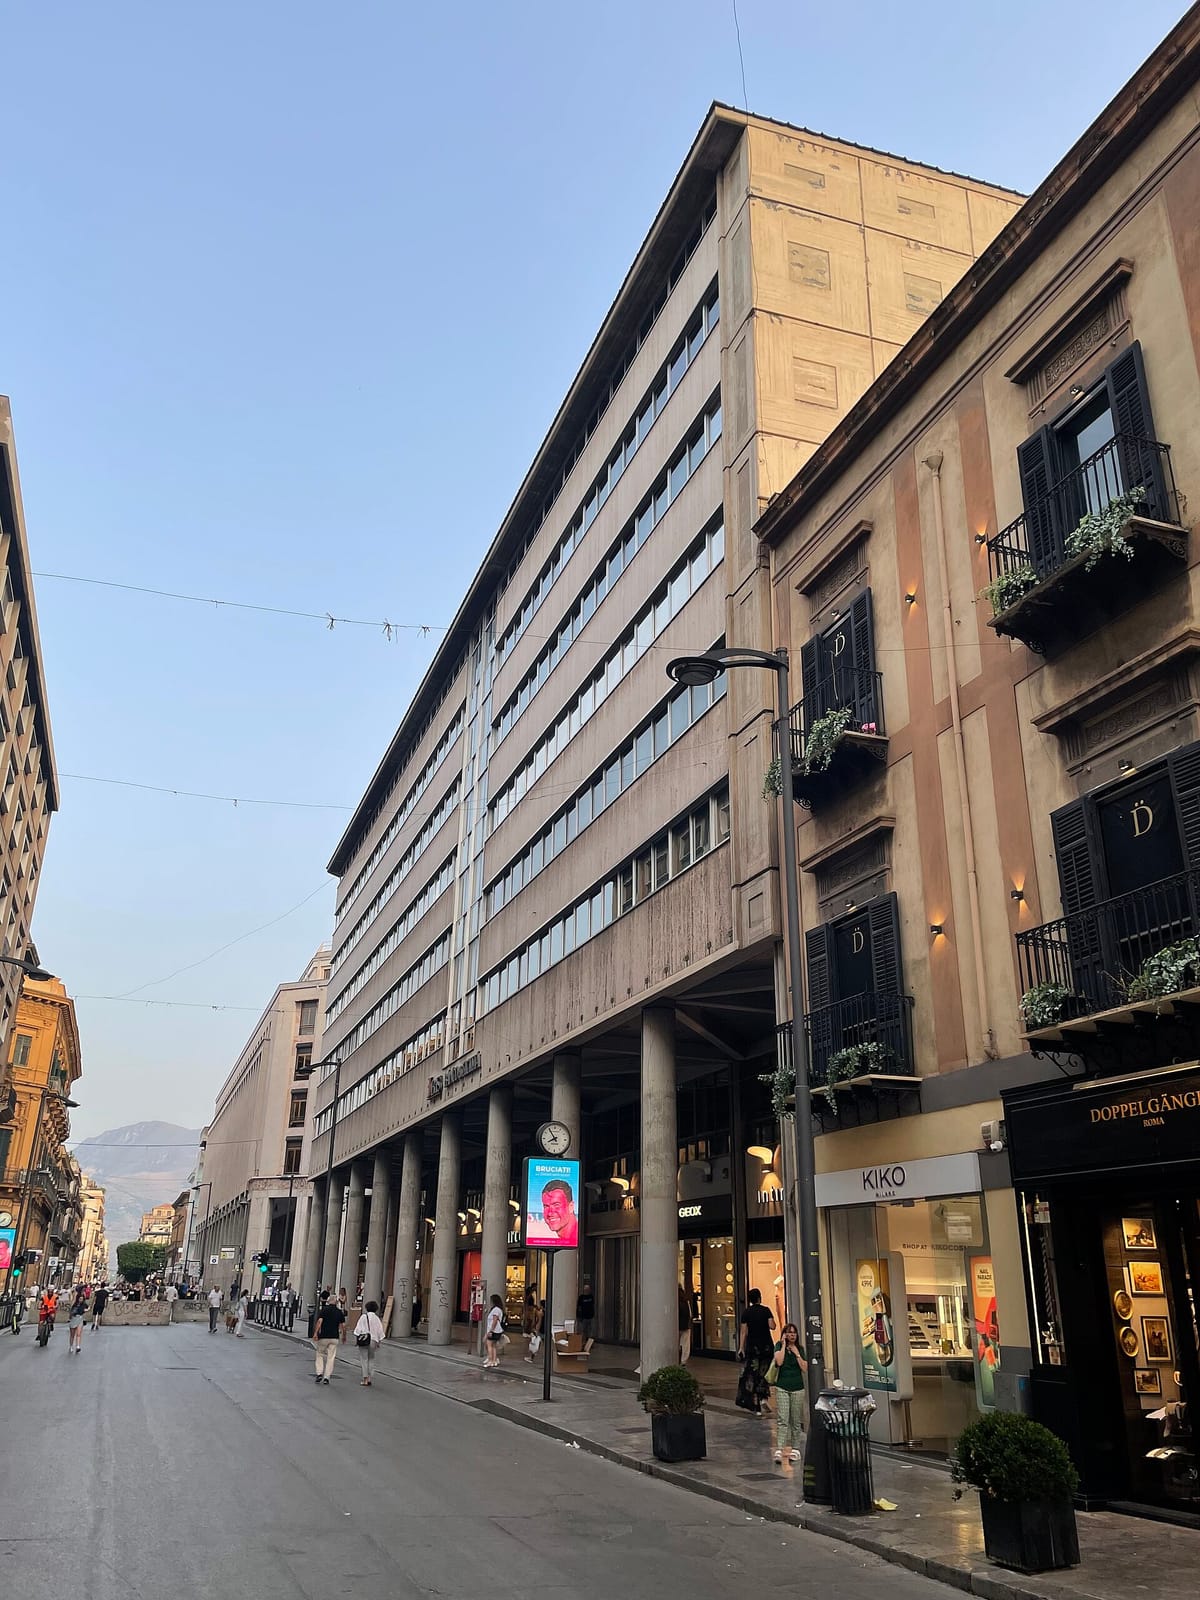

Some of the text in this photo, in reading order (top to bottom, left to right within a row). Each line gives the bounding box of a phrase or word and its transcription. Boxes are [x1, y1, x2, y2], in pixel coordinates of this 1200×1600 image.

[1143, 1116, 1165, 1128] ROMA
[862, 1166, 906, 1191] KIKO
[678, 1205, 702, 1218] GEOX
